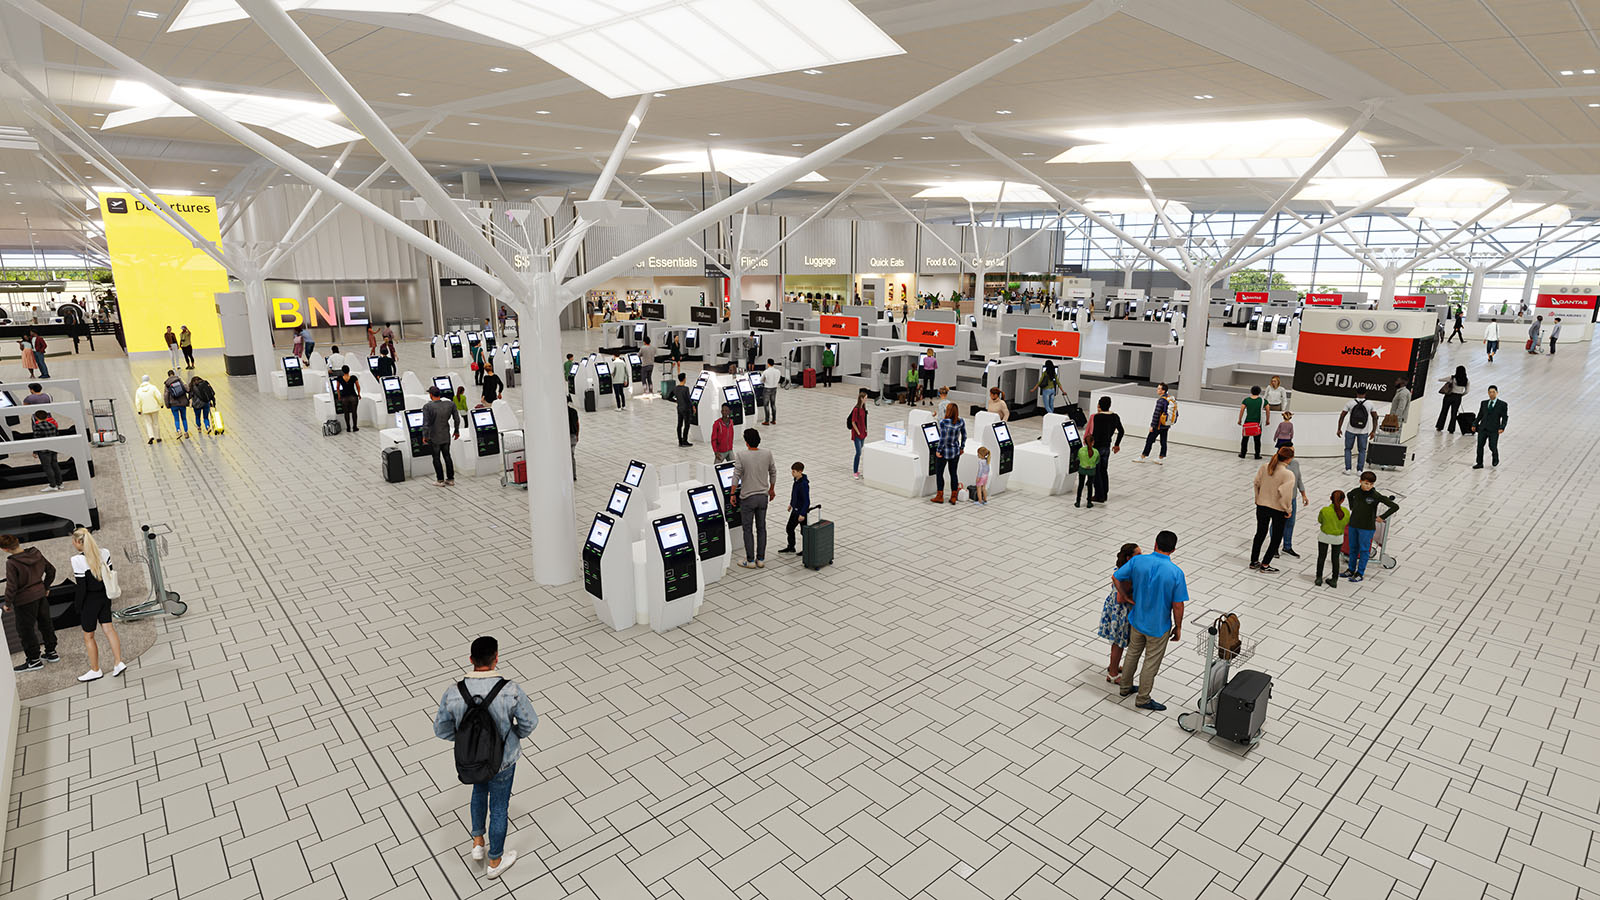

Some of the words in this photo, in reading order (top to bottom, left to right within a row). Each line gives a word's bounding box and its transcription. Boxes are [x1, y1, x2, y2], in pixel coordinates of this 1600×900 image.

[135, 201, 211, 213] Drtures
[648, 256, 698, 268] Essentials
[804, 255, 837, 267] Luggage
[870, 257, 889, 267] Quick
[890, 257, 905, 267] Eats
[926, 257, 941, 267] Food
[942, 257, 947, 267] &
[272, 296, 369, 328] BNE
[1341, 346, 1374, 357] Jetstar
[1325, 373, 1353, 388] FIJI
